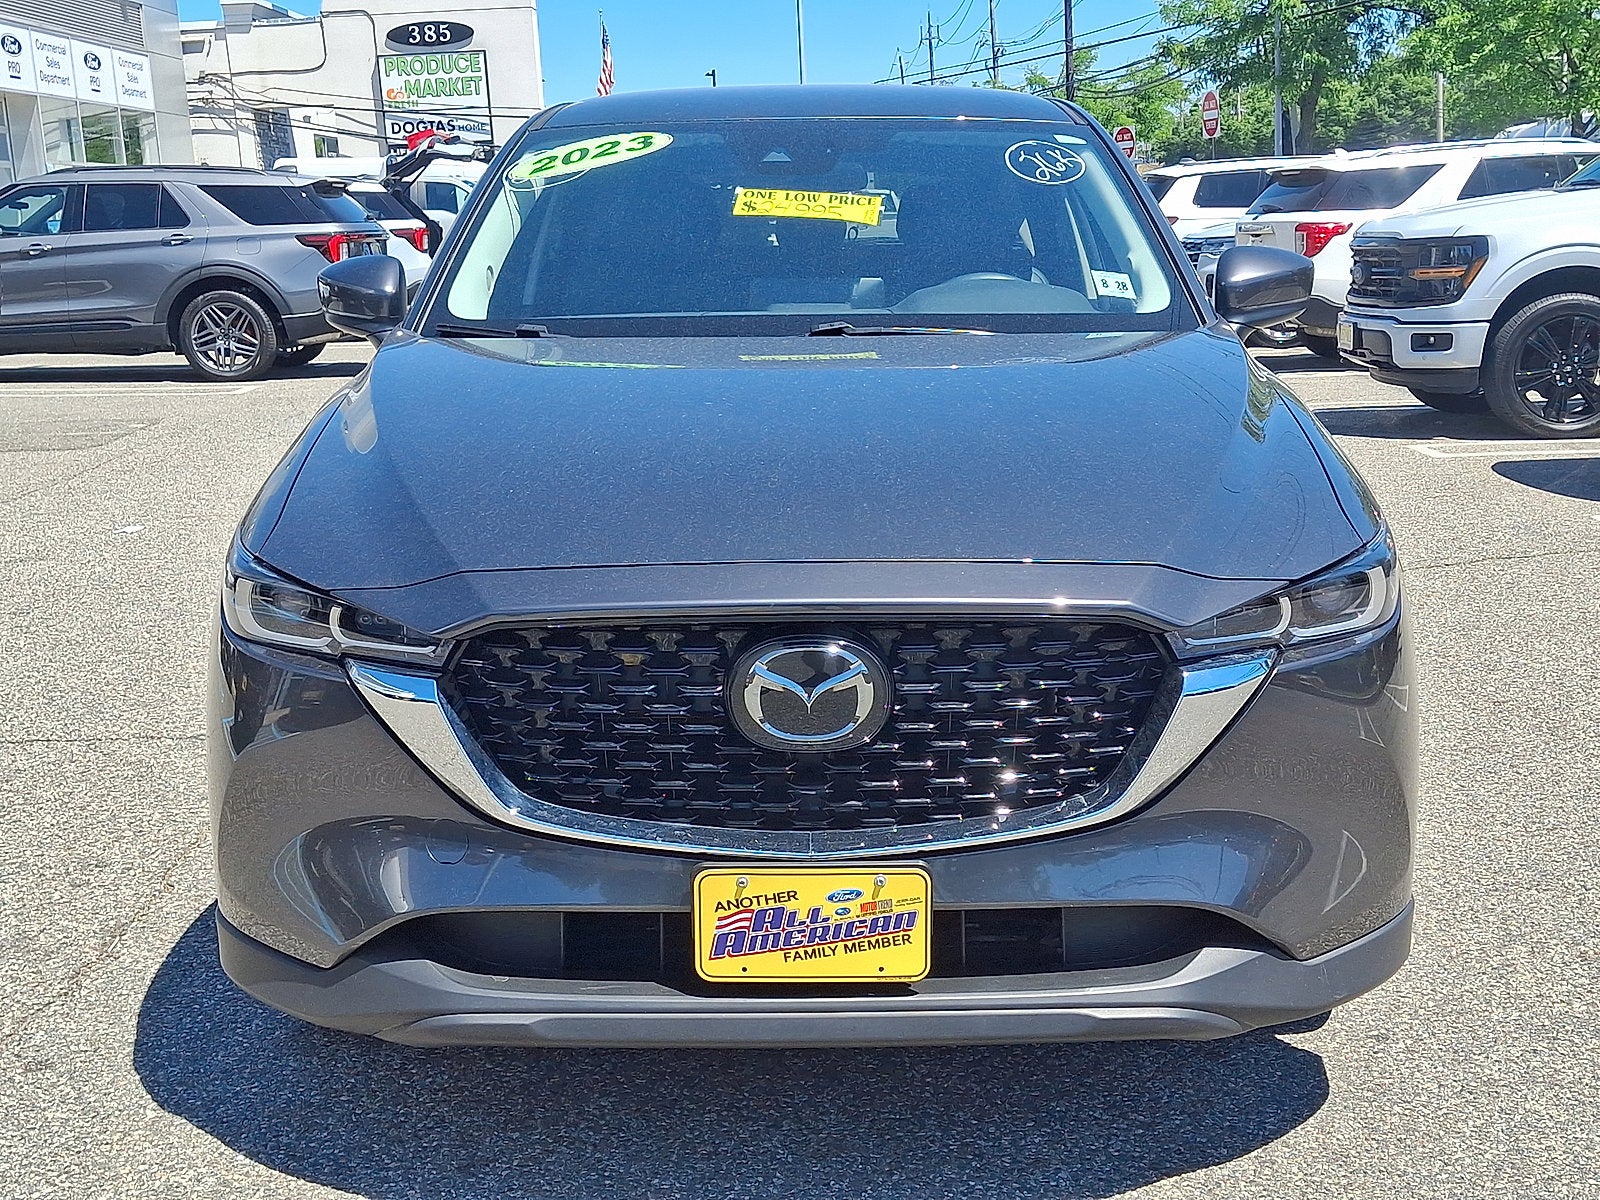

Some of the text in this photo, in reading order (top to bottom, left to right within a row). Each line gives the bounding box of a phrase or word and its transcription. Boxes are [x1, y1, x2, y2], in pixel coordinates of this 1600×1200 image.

[408, 24, 452, 44] 385
[35, 38, 67, 56] Commercial
[7, 60, 21, 74] PRO
[45, 55, 61, 70] Sales
[117, 56, 145, 71] Commercial
[384, 53, 482, 78] PRODUCE
[39, 70, 71, 86] Department
[89, 75, 101, 87] PRO
[126, 72, 139, 84] Sales
[121, 84, 148, 98] Department
[404, 76, 483, 99] MARKET
[458, 123, 487, 132] HOME
[528, 135, 654, 176] 2023
[743, 190, 878, 206] ONE LOW PRICE
[1100, 278, 1129, 291] 8 28
[715, 890, 799, 913] ANOTHER
[832, 890, 859, 902] Ford
[860, 901, 877, 913] MOTOR
[750, 905, 831, 933] ALL
[712, 911, 918, 957] AMERICAN
[783, 933, 912, 963] FAMILY MEMBER
